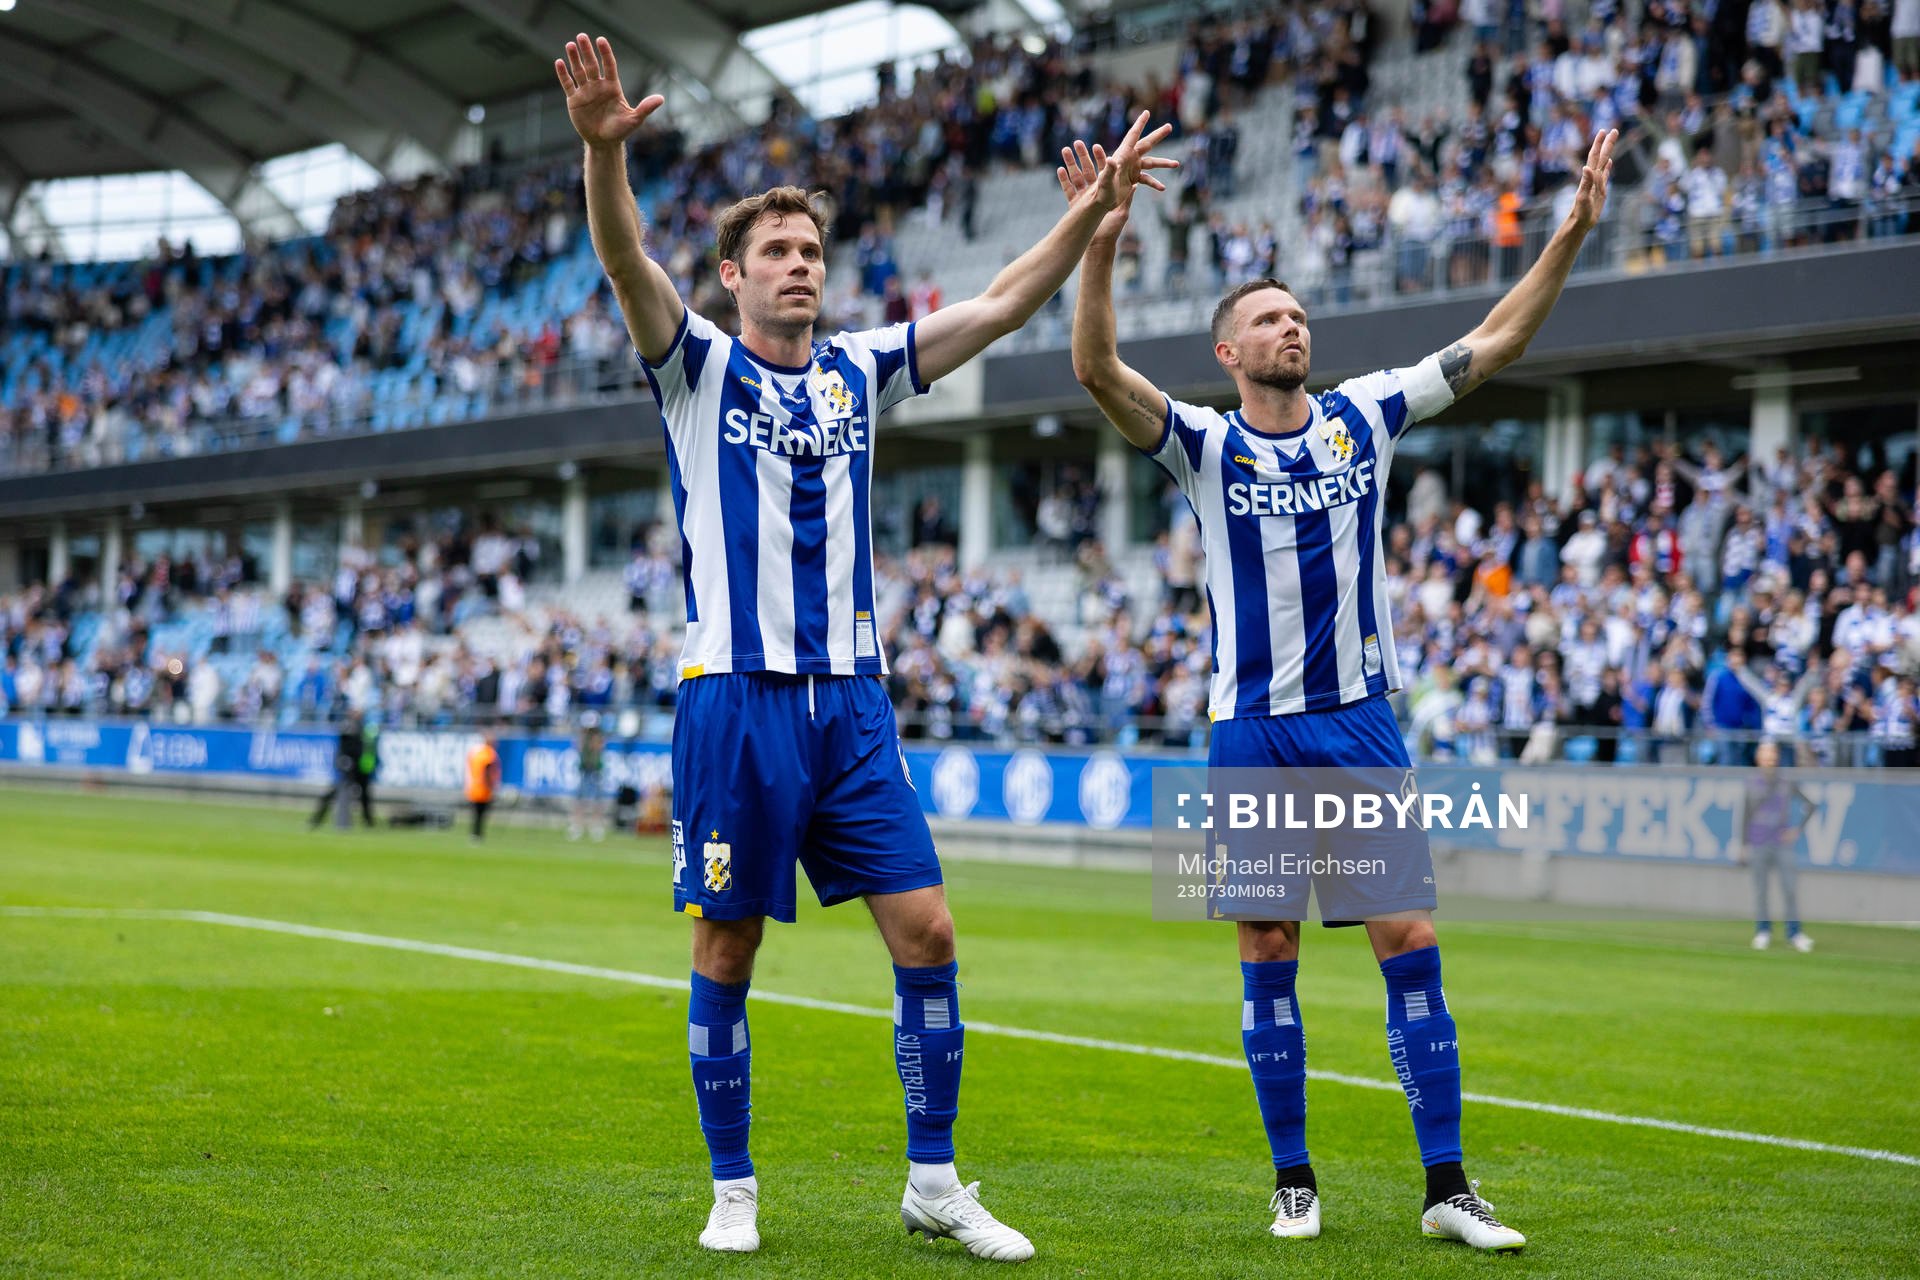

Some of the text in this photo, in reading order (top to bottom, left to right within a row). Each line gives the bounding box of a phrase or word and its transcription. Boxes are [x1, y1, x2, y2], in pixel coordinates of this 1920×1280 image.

[724, 408, 867, 456] SERNEKE
[1228, 460, 1374, 516] SERNEKE
[1498, 772, 1858, 866] EFFEKTV.
[946, 1048, 963, 1063] IF
[1251, 1051, 1289, 1063] IFK
[705, 1077, 742, 1091] IFK
